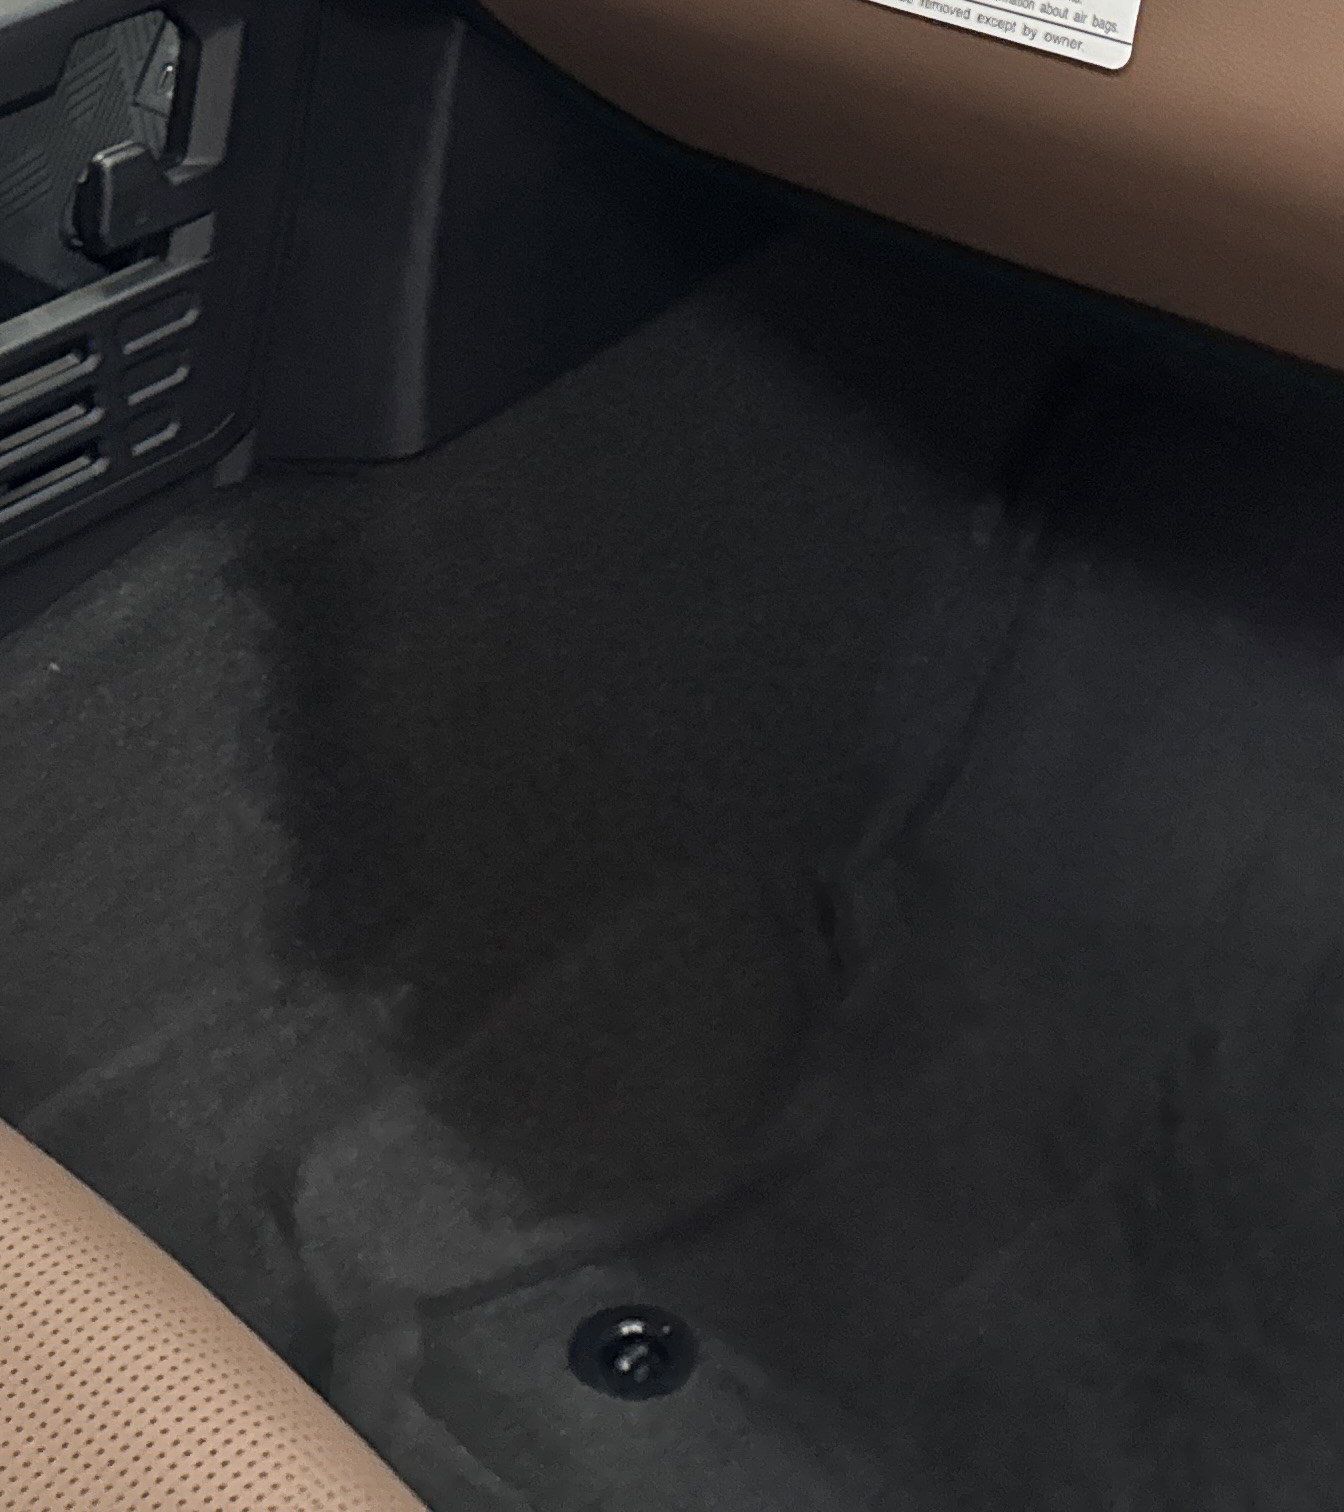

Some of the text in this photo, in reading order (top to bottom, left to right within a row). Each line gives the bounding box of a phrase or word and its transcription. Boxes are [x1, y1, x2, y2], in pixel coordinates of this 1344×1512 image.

[1039, 2, 1069, 19] about
[1073, 11, 1088, 24] air
[976, 14, 1016, 33] except
[1021, 23, 1038, 40] by
